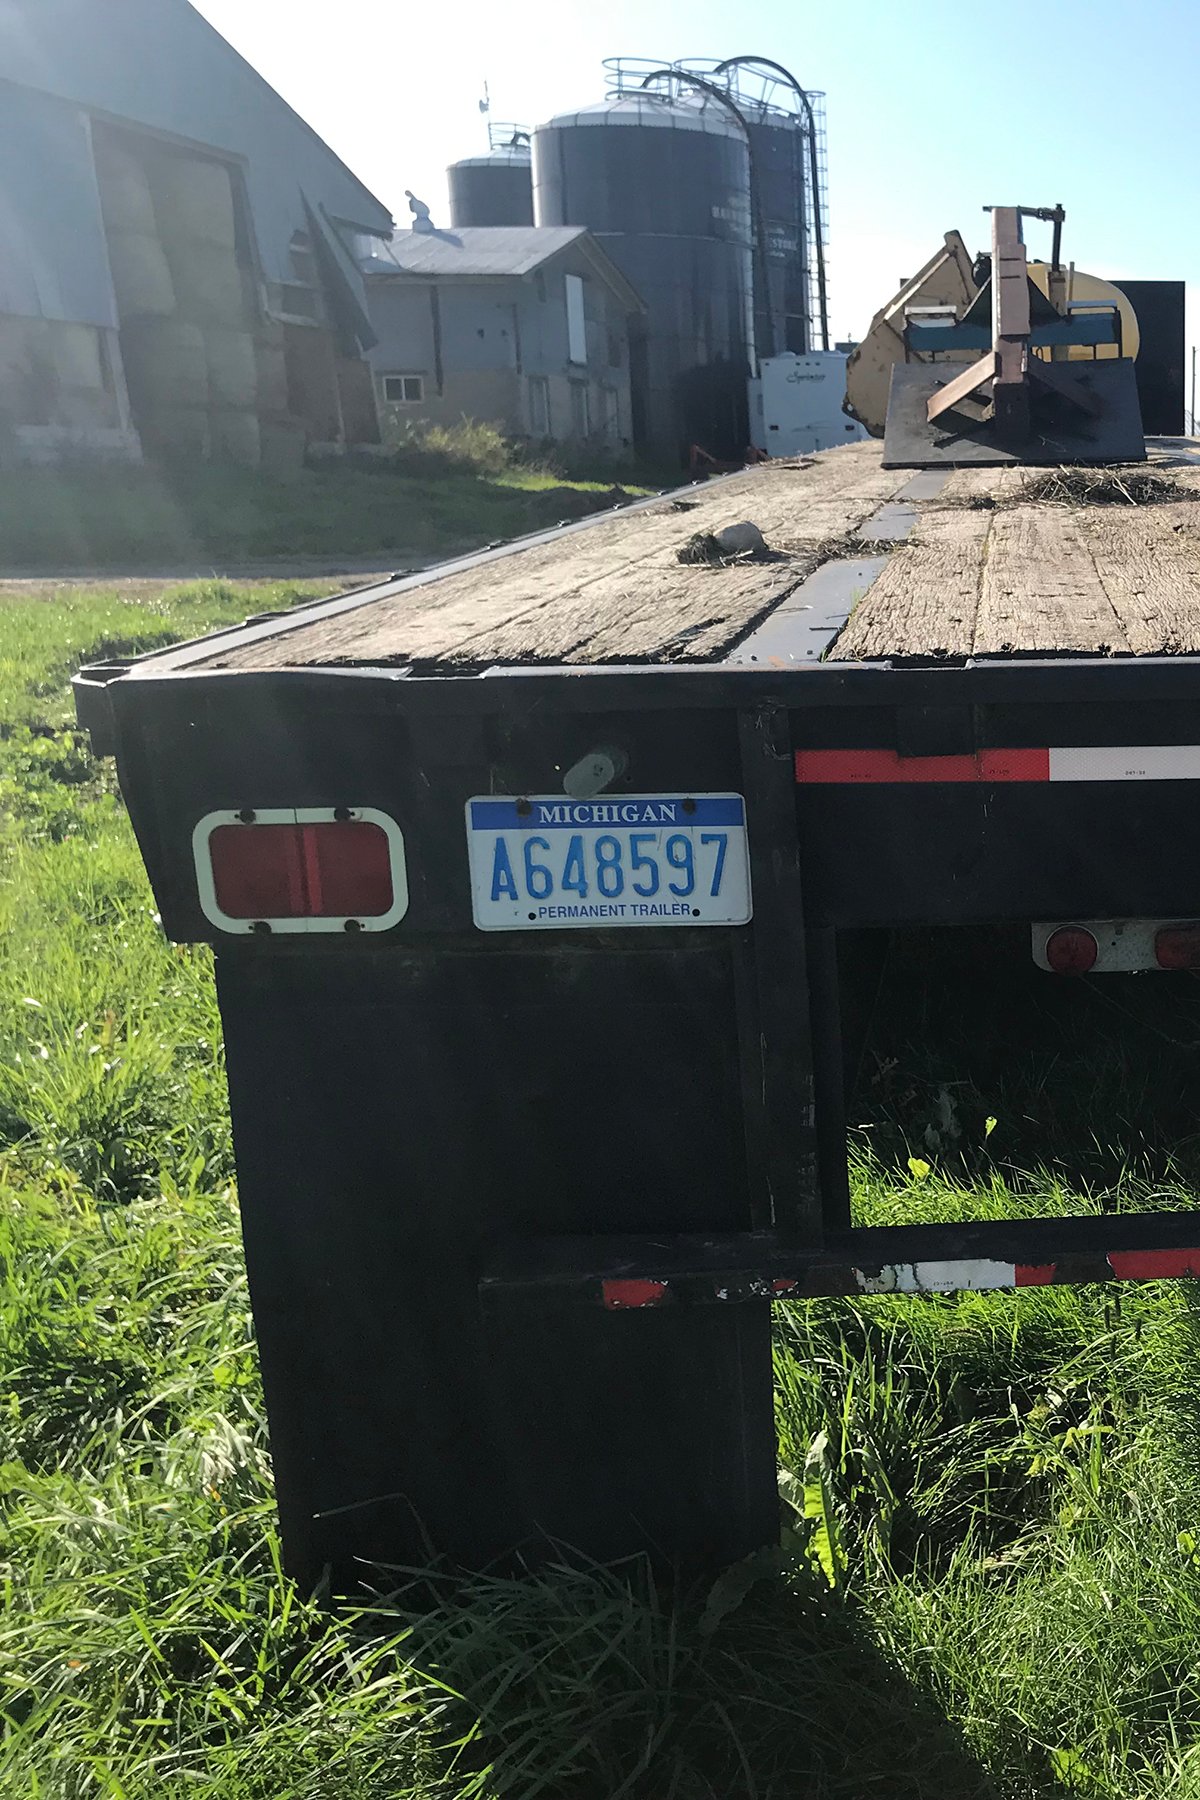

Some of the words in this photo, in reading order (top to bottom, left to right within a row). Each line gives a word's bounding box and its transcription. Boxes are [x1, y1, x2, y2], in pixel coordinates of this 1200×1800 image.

[539, 803, 677, 824] MICHIGAN
[490, 833, 728, 901] A648597
[539, 904, 626, 919] PERMANENT
[630, 903, 691, 918] TRAILER
